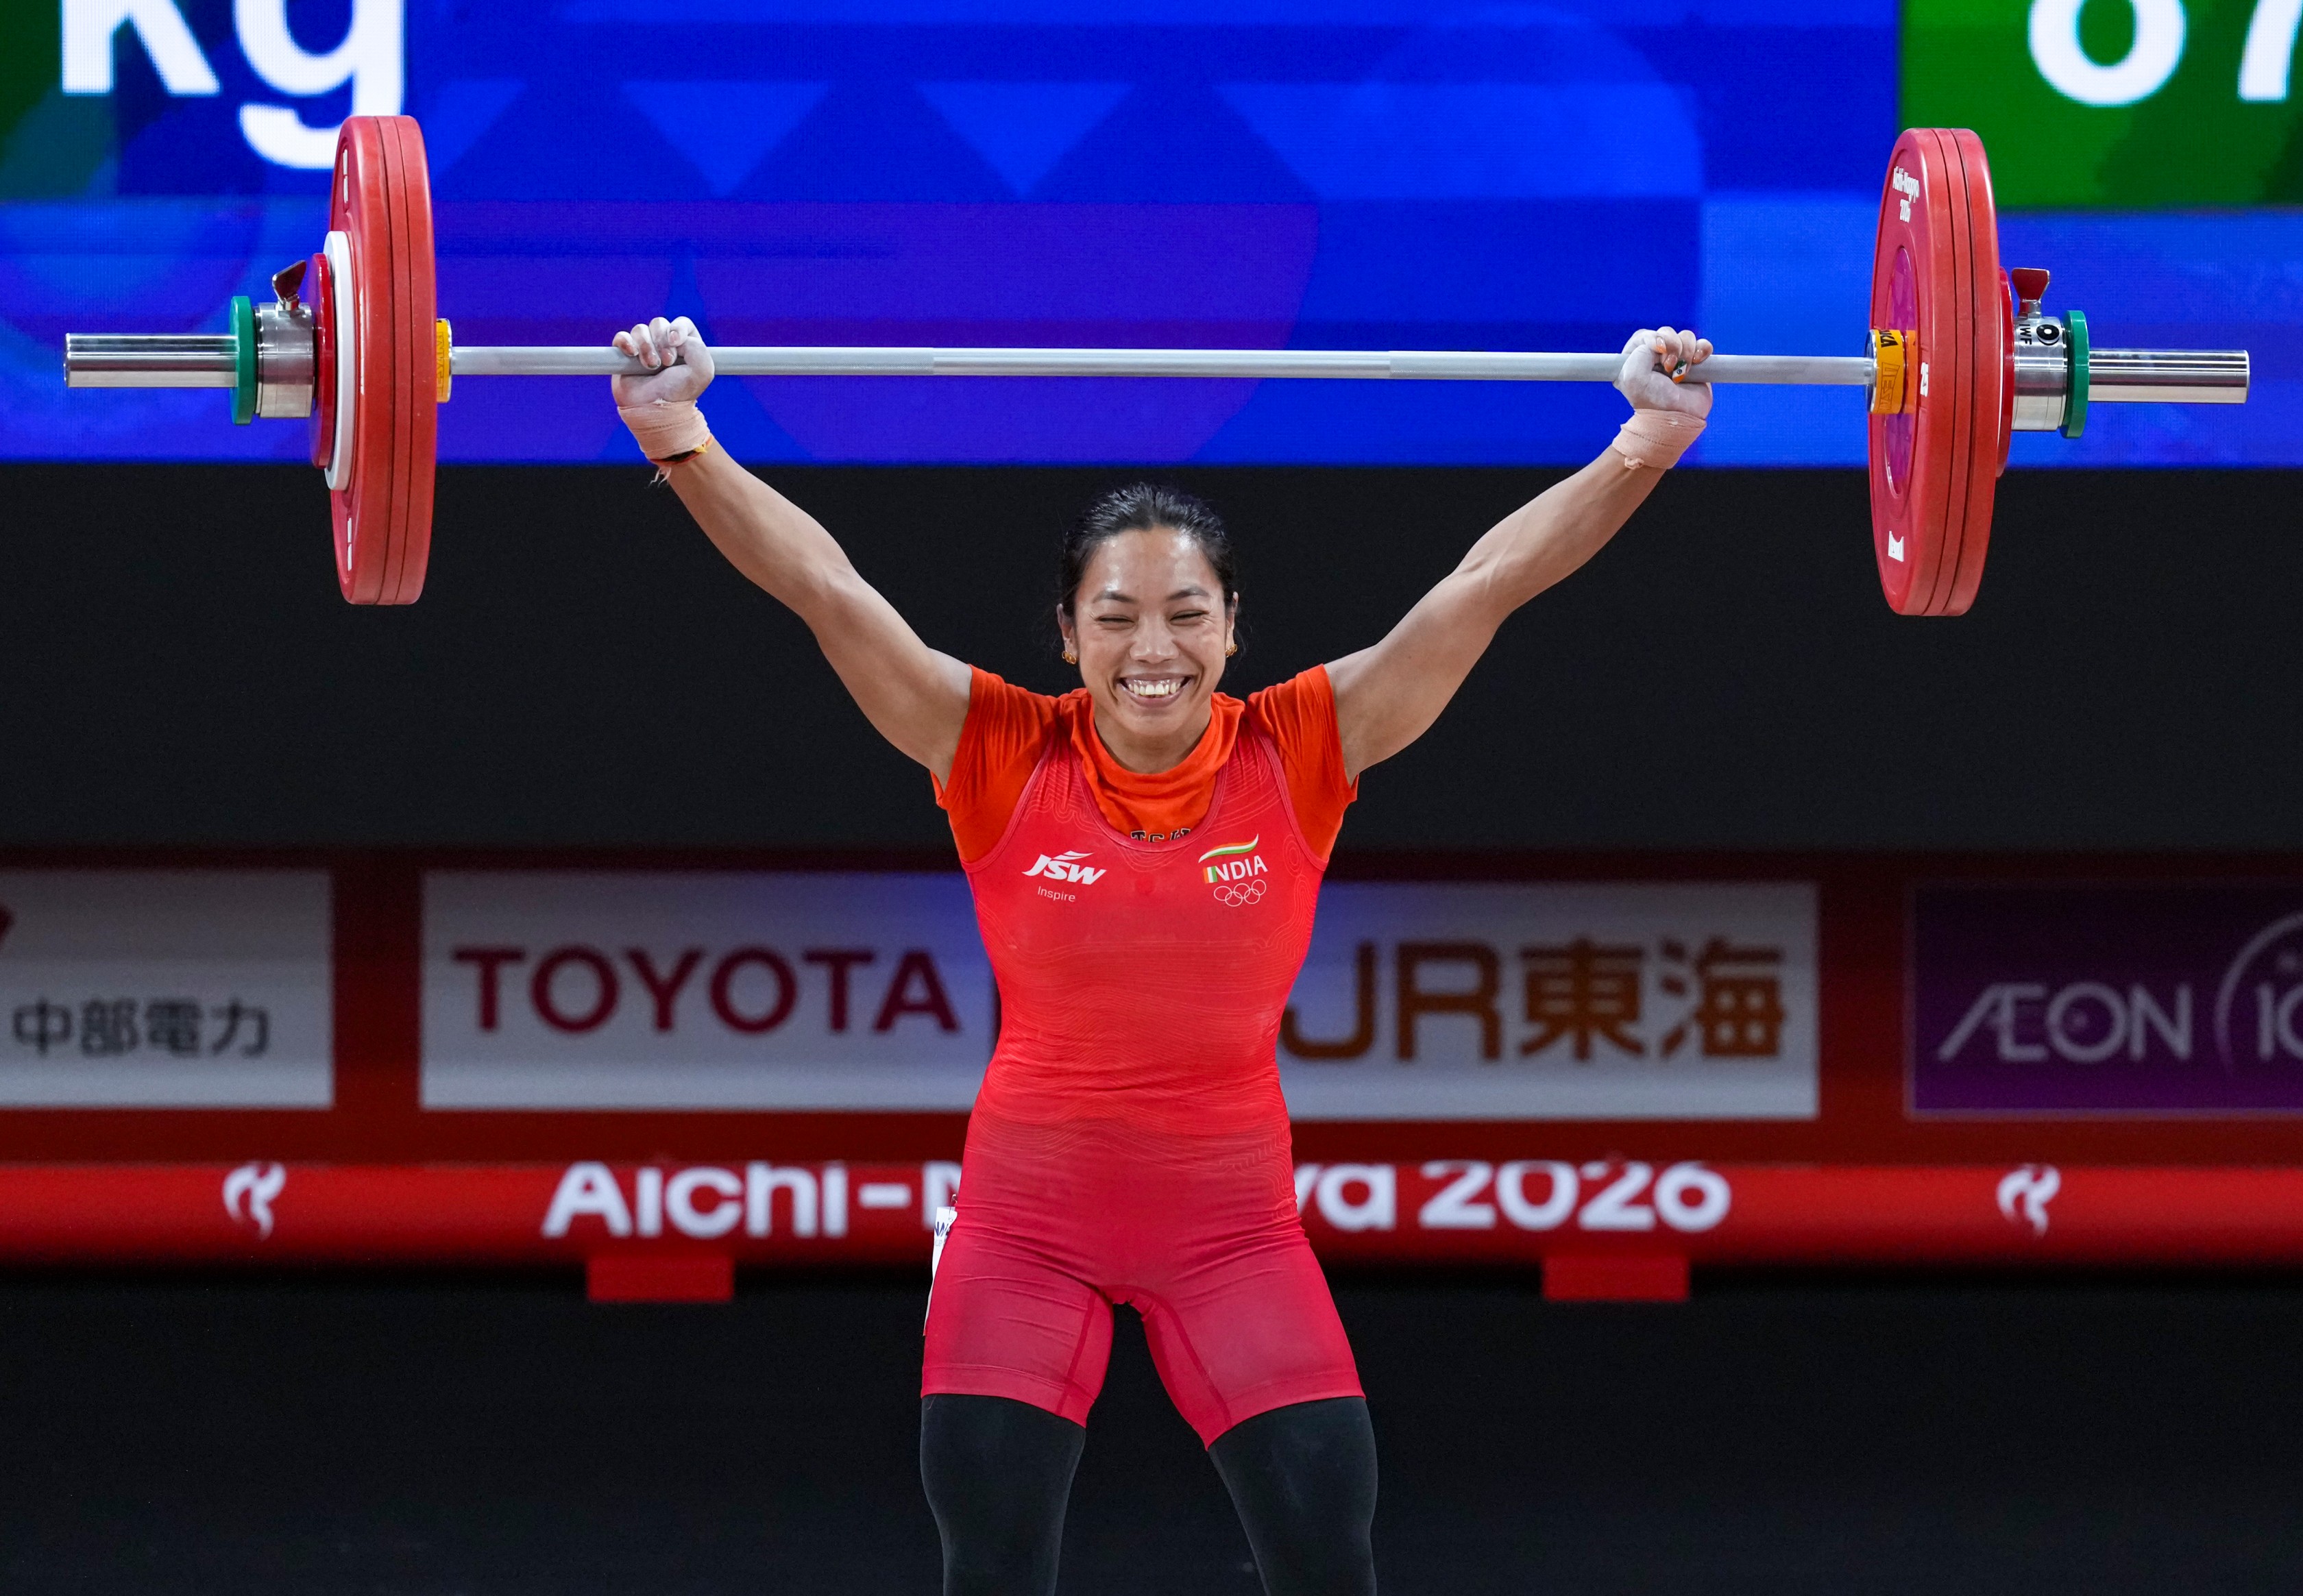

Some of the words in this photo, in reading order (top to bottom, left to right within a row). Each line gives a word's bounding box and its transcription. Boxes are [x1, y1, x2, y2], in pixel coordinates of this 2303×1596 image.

[2019, 323, 2032, 345] IWF
[1021, 853, 1107, 885] JSW
[1203, 855, 1268, 884] INDIA
[1037, 885, 1075, 903] Inspire
[450, 944, 960, 1035] TOYOTA
[1280, 936, 1787, 1062] JR東海
[12, 997, 270, 1059] 中部電力
[1417, 1159, 1731, 1232] 2026
